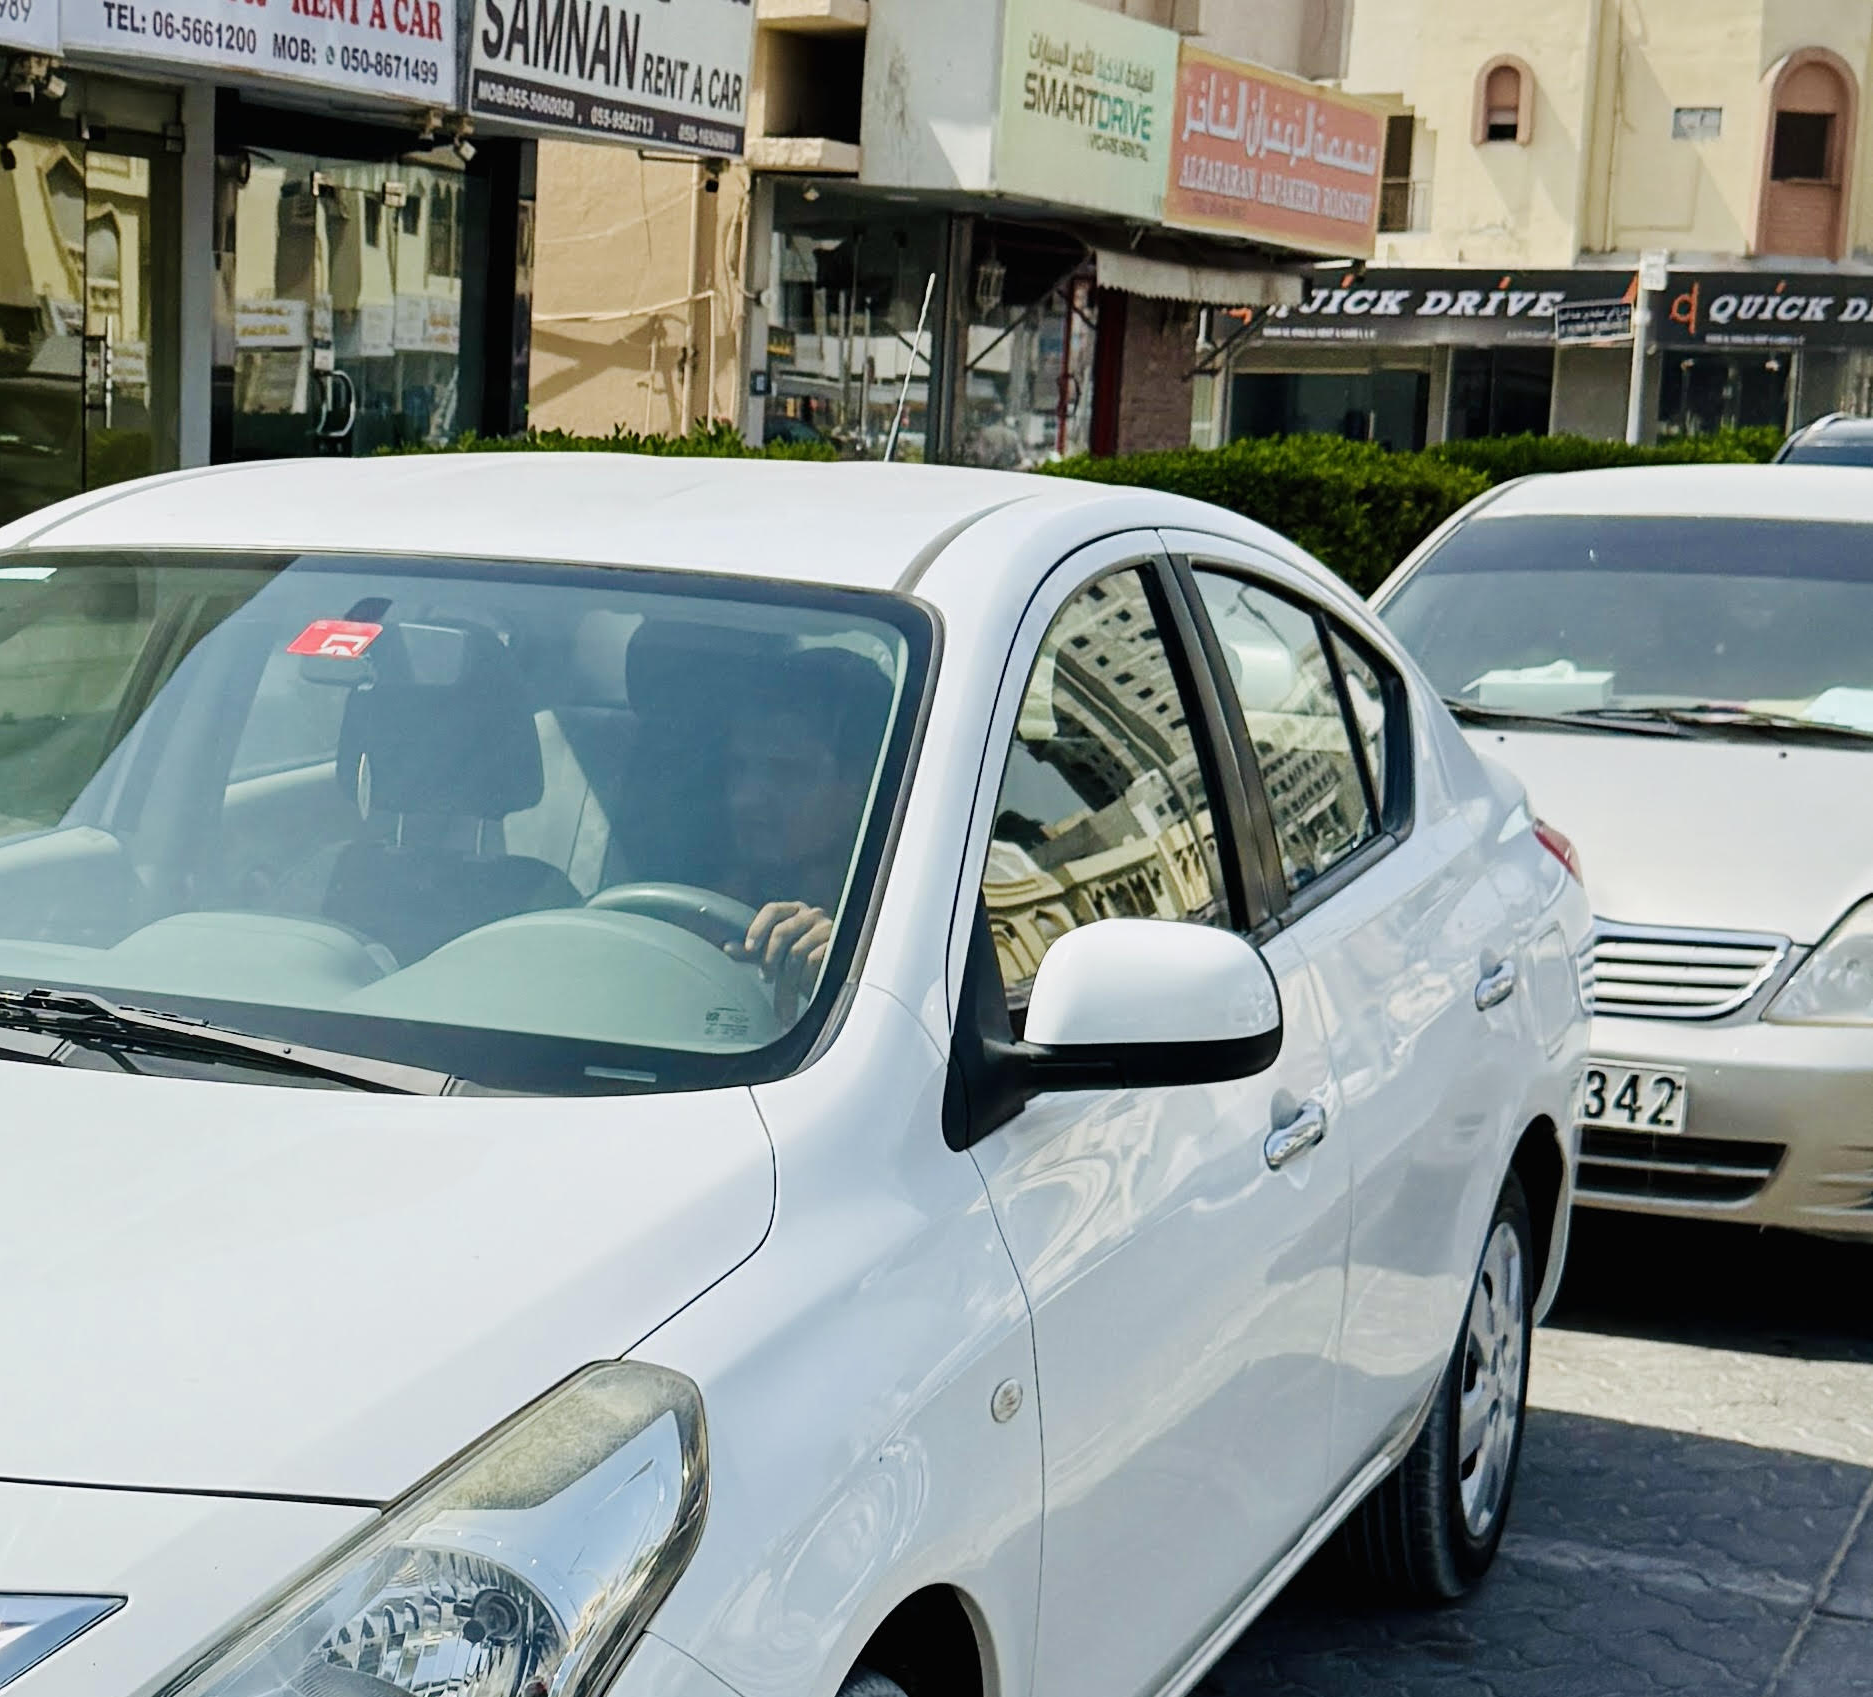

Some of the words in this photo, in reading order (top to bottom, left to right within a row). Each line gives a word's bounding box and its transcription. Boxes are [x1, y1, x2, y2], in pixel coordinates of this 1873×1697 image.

[103, 2, 146, 34] TEL:
[153, 10, 256, 54] 06-5661200
[273, 34, 316, 65] MOB:
[341, 45, 439, 85] 050-8671499
[393, 0, 443, 42] CAR
[481, 0, 640, 90] SAMNAN
[641, 52, 689, 100] RENT
[691, 64, 703, 107] A
[708, 68, 742, 113] CAR
[1583, 1070, 1677, 1128] 342
